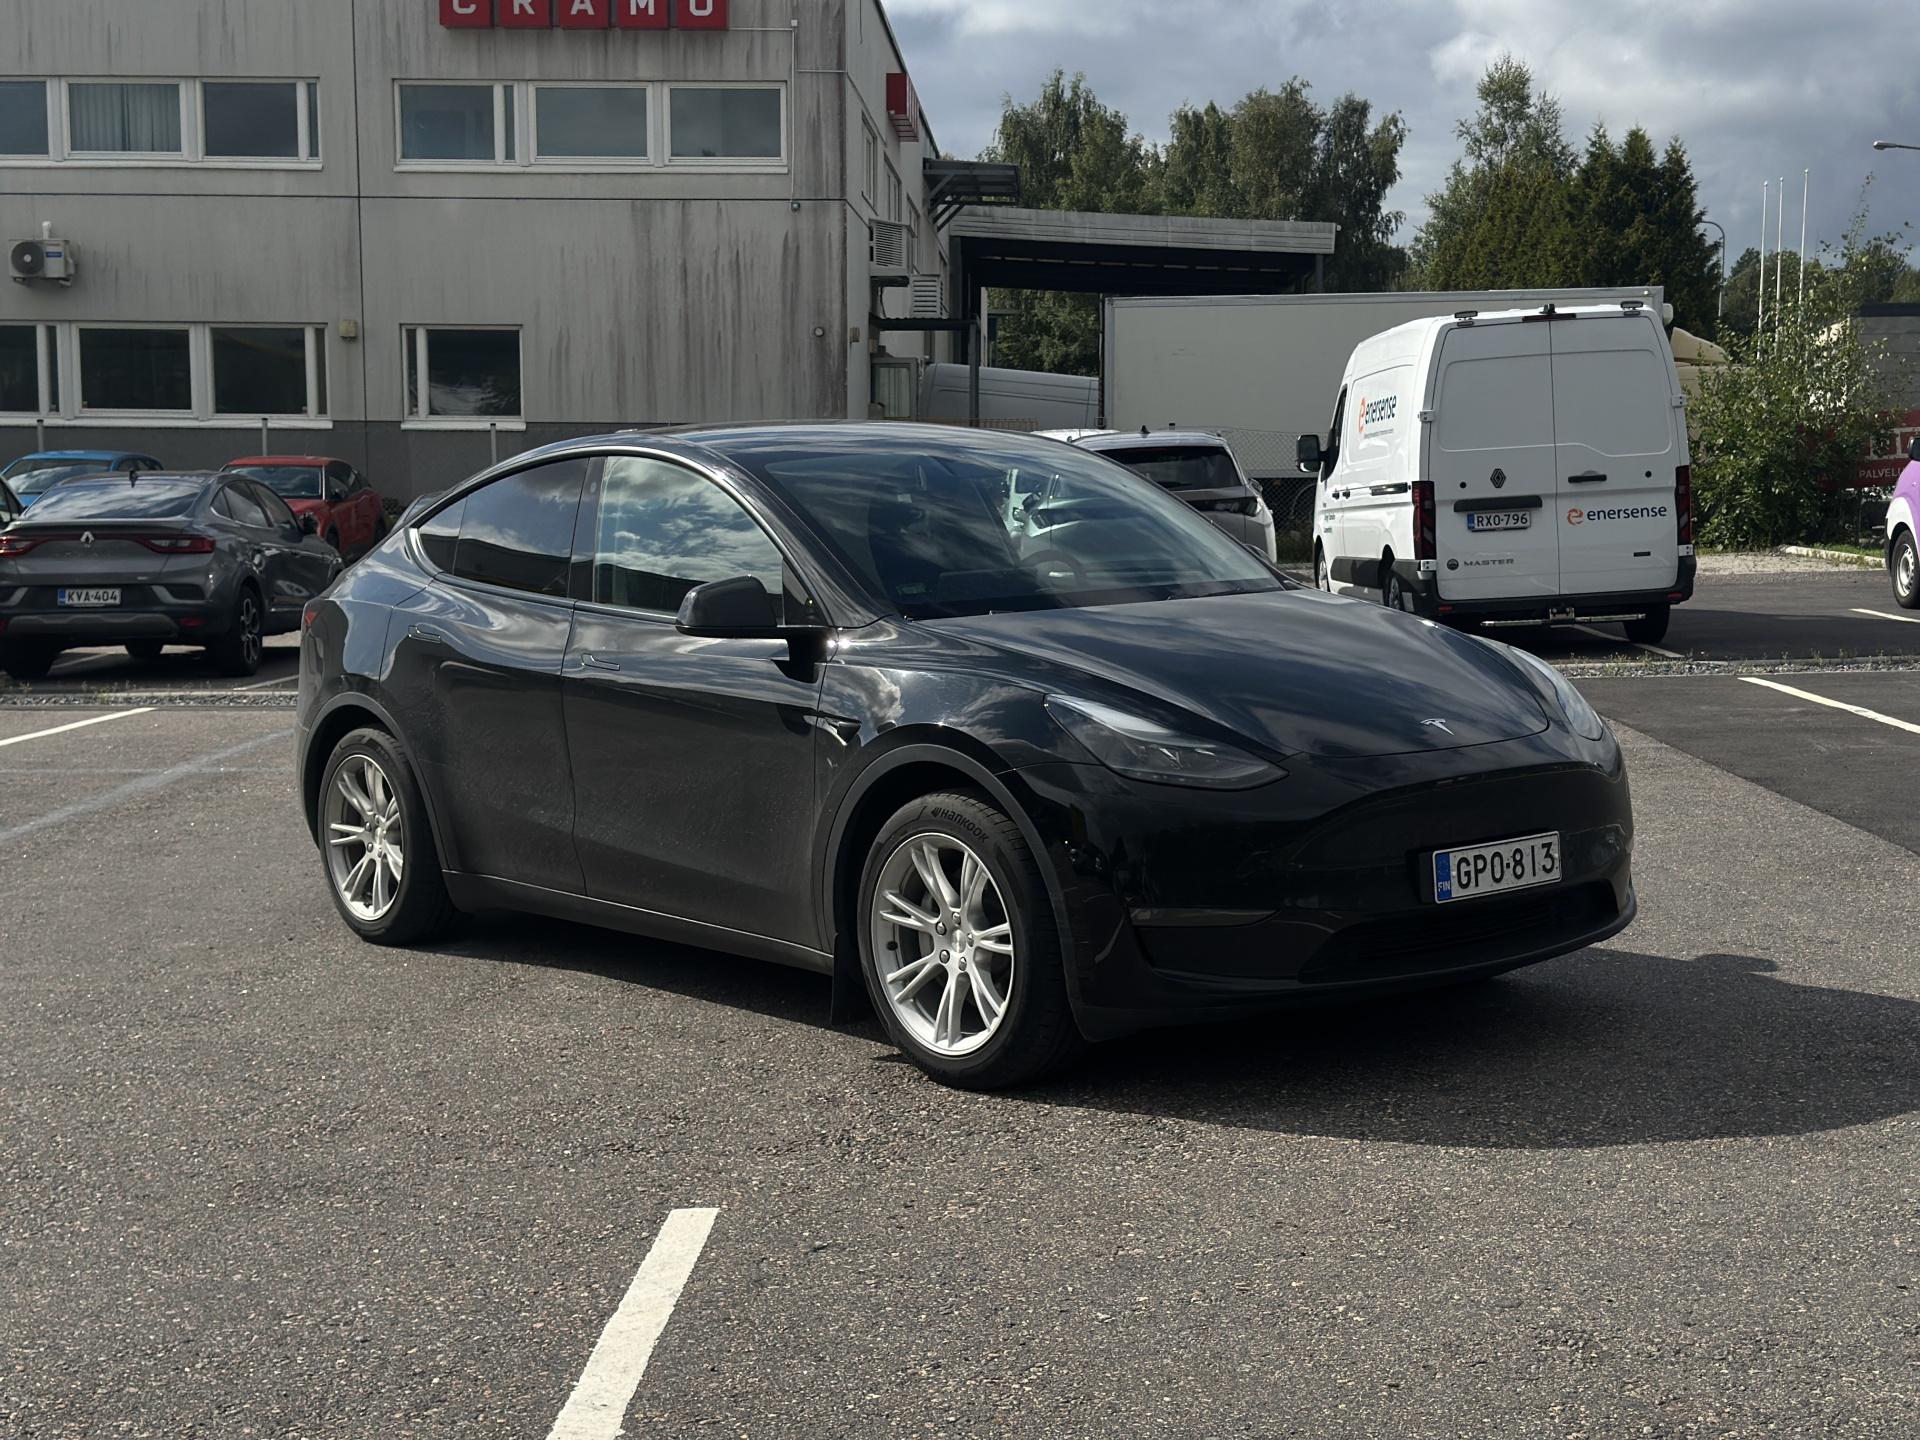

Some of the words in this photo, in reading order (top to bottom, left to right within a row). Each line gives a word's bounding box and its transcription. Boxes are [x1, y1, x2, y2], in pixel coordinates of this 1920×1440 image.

[1365, 395, 1397, 424] enersense
[1476, 513, 1528, 527] RXO-796
[1587, 506, 1667, 521] enersense
[1464, 558, 1513, 566] MASTER
[1438, 880, 1451, 892] FIN
[1456, 842, 1555, 889] GPO-813
